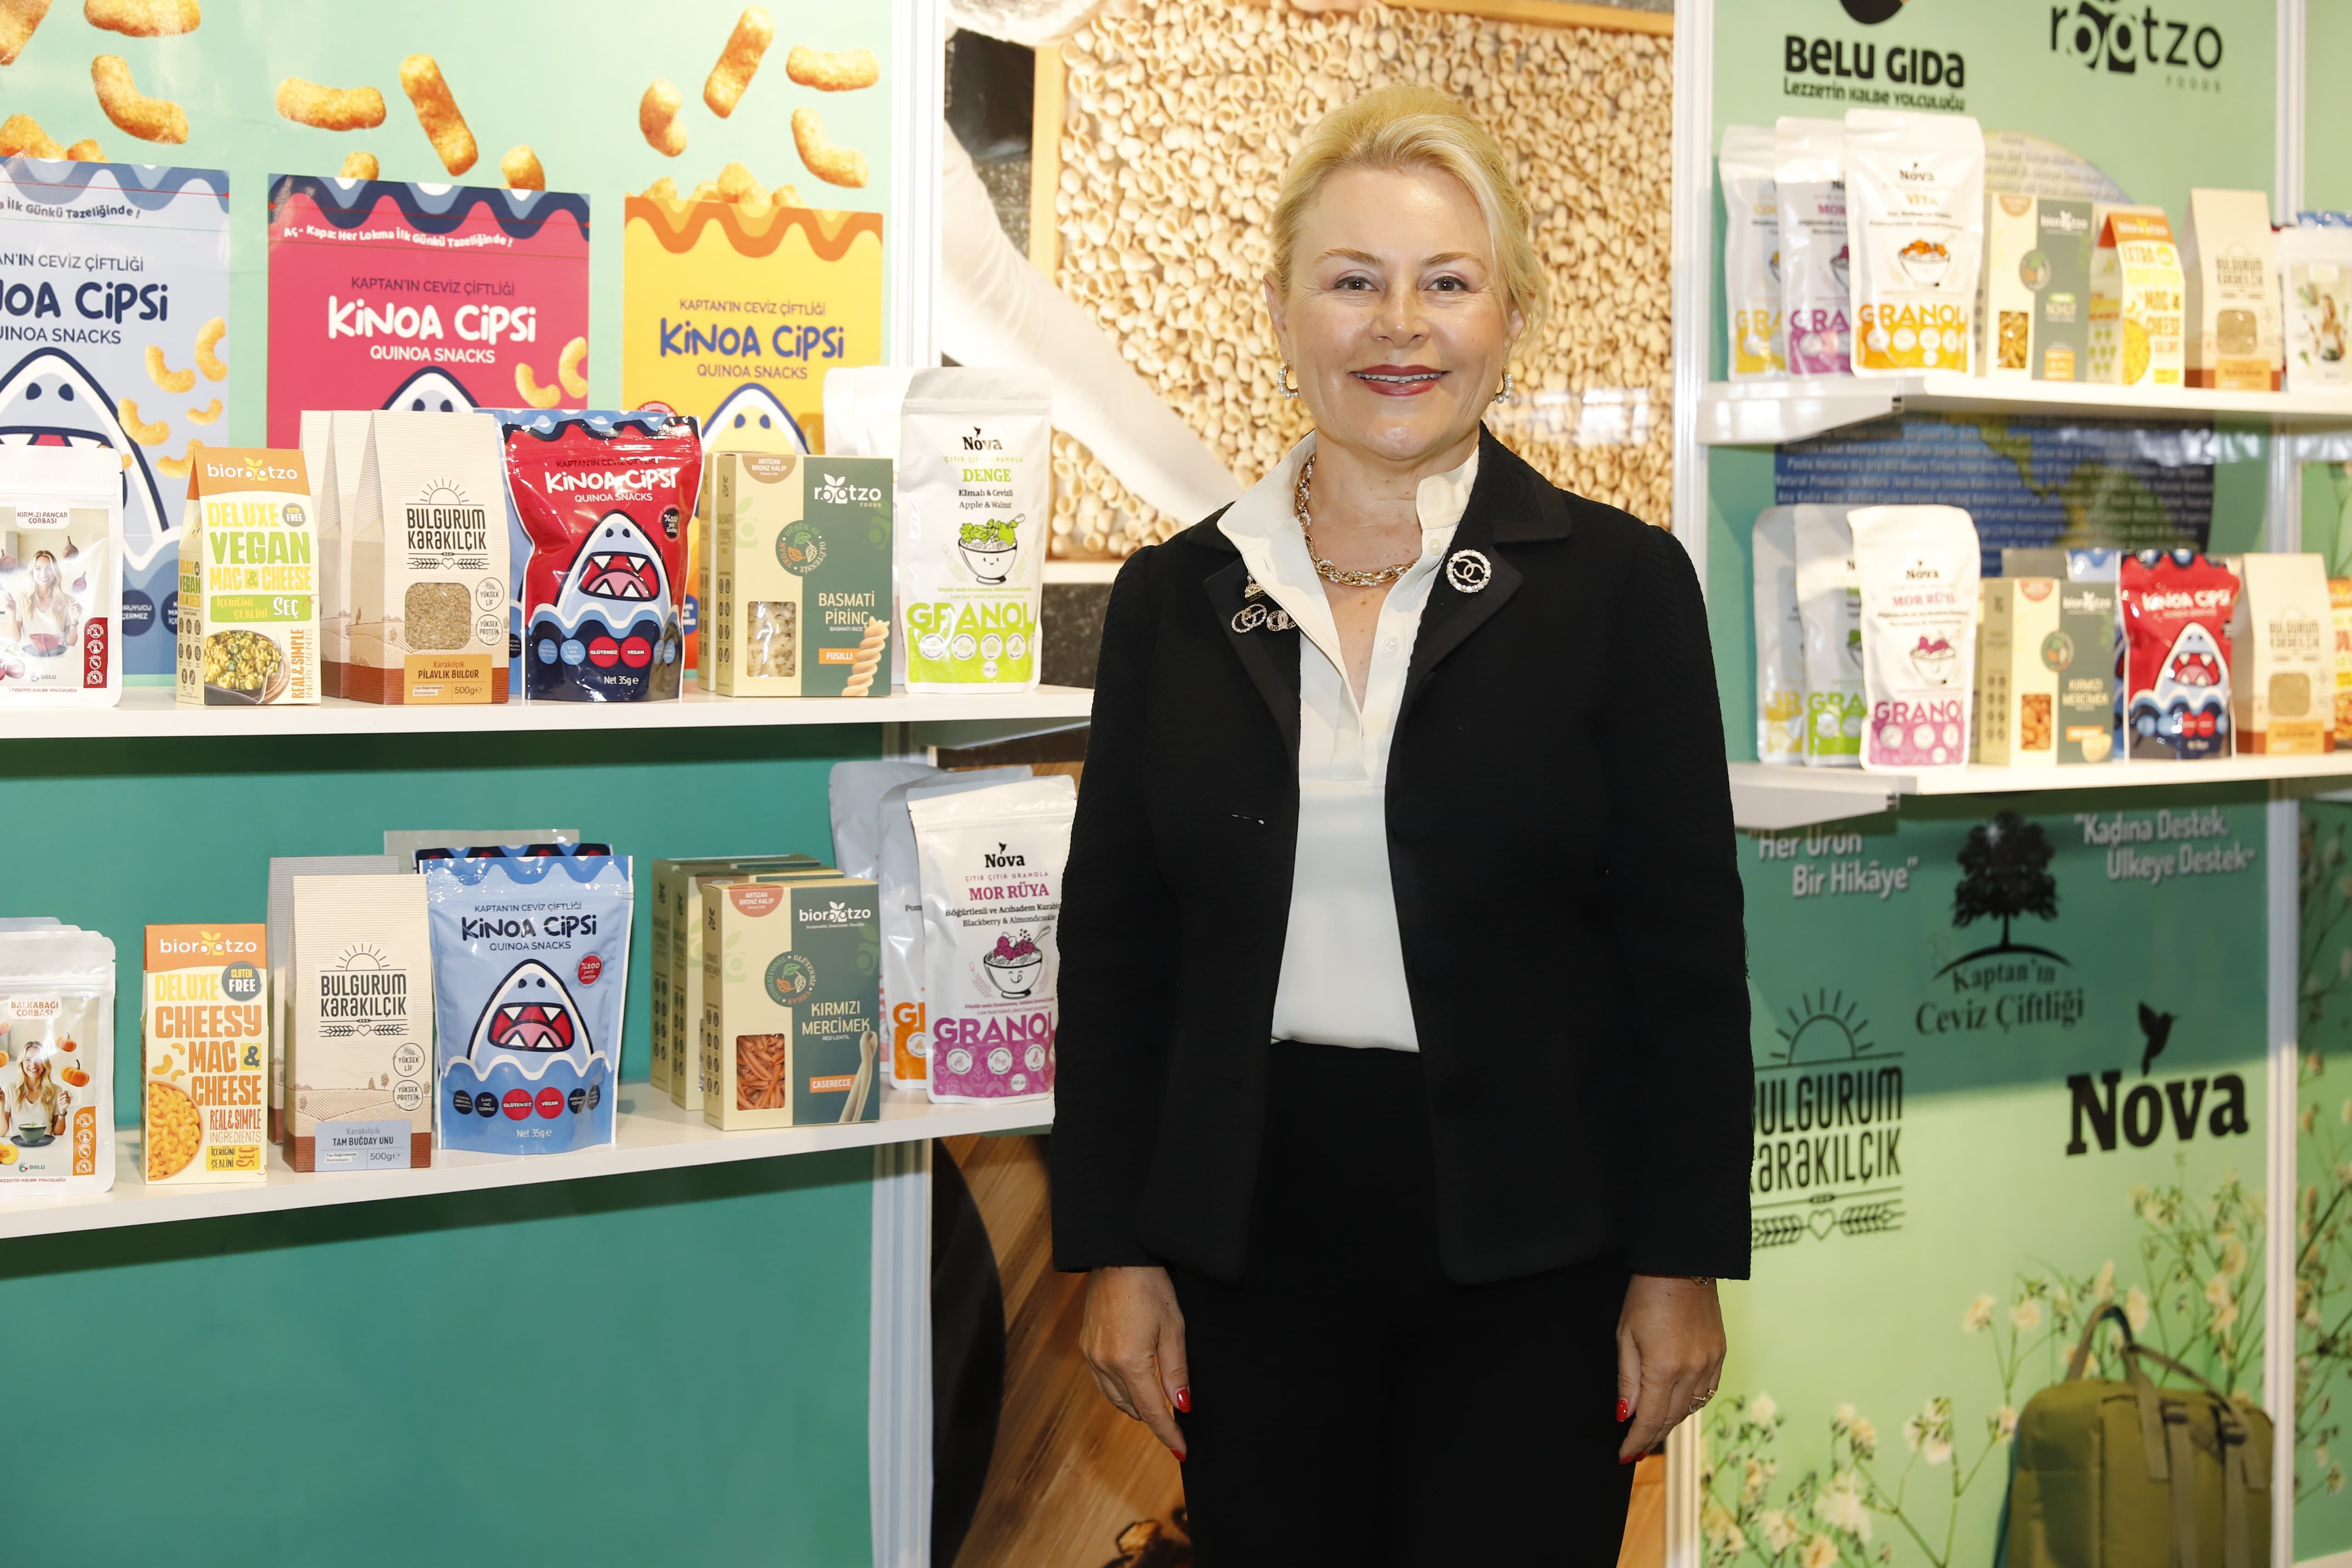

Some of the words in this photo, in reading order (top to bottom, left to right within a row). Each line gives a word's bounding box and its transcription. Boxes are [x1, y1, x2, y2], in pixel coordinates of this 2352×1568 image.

[26, 204, 63, 218] Günkü
[67, 205, 133, 219] Tazeliğinde
[338, 231, 357, 241] Her
[359, 230, 395, 240] Lokma
[396, 226, 411, 241] İlk
[413, 233, 446, 247] Günkü
[448, 234, 507, 248] Tazeliğinde
[39, 253, 81, 268] CEVİZ
[85, 255, 144, 272] ÇİFTLİĞİ
[351, 277, 420, 292] KAPTAN'IN
[423, 279, 460, 294] CEVİZ
[464, 279, 514, 296] ÇİFTLİĞİ
[680, 299, 741, 312] KAPTAN'IN
[744, 300, 777, 314] CEVİZ
[780, 300, 826, 317] ÇİFTLİĞİ
[1789, 309, 1849, 333] GRA
[52, 328, 121, 344] SNACKS
[370, 345, 432, 362] QUINOA
[434, 348, 496, 364] SNACKS
[697, 364, 751, 378] QUINOA
[754, 366, 808, 379] SNACKS
[962, 469, 1012, 482] DENGE
[575, 493, 614, 503] QUINOA
[615, 493, 653, 501] SNACKS
[959, 501, 983, 510] Apple
[206, 503, 280, 527] DELUXE
[286, 514, 303, 522] FREE
[407, 509, 486, 529] BULGURUM
[784, 523, 810, 537] DÜŞÜK
[209, 532, 311, 564] VEGAN
[779, 541, 793, 569] VEGAN
[180, 575, 200, 594] VEGAN
[209, 567, 242, 591] MAC
[262, 566, 311, 591] CHEESE
[819, 591, 875, 607] BASMATİ
[825, 608, 869, 628] PİRİNÇ
[434, 661, 464, 669] Karakılçık
[418, 669, 450, 679] PİLAVLIK
[452, 670, 479, 678] BULGUR
[604, 676, 617, 685] Net
[1875, 701, 1963, 724] GRANO
[1793, 864, 1826, 897] Bir
[969, 886, 1005, 901] MOR
[1007, 882, 1050, 898] RÜYA
[521, 902, 545, 911] CEVİZ
[548, 901, 582, 912] ÇİFTLİĞİ
[945, 907, 988, 918] Böğürtlenli
[999, 905, 1035, 914] Acıbadem
[963, 918, 1001, 927] Blackberry
[490, 942, 530, 951] QUINOA
[531, 941, 571, 950] SNACKS
[155, 974, 219, 1001] DELUXE
[229, 979, 256, 992] FREE
[321, 974, 407, 996] BULGURUM
[11, 1000, 58, 1009] BALKABAĞI
[811, 1001, 860, 1017] KIRMIZI
[1916, 998, 1987, 1035] Ceviz
[1996, 988, 2084, 1034] Çiftliği
[16, 1009, 53, 1017] ÇORBASI
[155, 1005, 261, 1038] CHEESY
[802, 1017, 870, 1035] MERCİMEK
[189, 1040, 237, 1073] MAC
[192, 1075, 261, 1106] CHEESE
[812, 1079, 851, 1089] CASERECCE
[1753, 1066, 1902, 1135] ULGURUM
[2067, 1070, 2249, 1155] Nova
[210, 1131, 261, 1143] INGREDIENTS
[346, 1127, 380, 1136] Karakılçık
[516, 1129, 530, 1138] Net
[333, 1138, 347, 1146] TAM
[349, 1136, 377, 1145] BUĞDAY
[211, 1157, 234, 1169] ŞEKLİNİ
